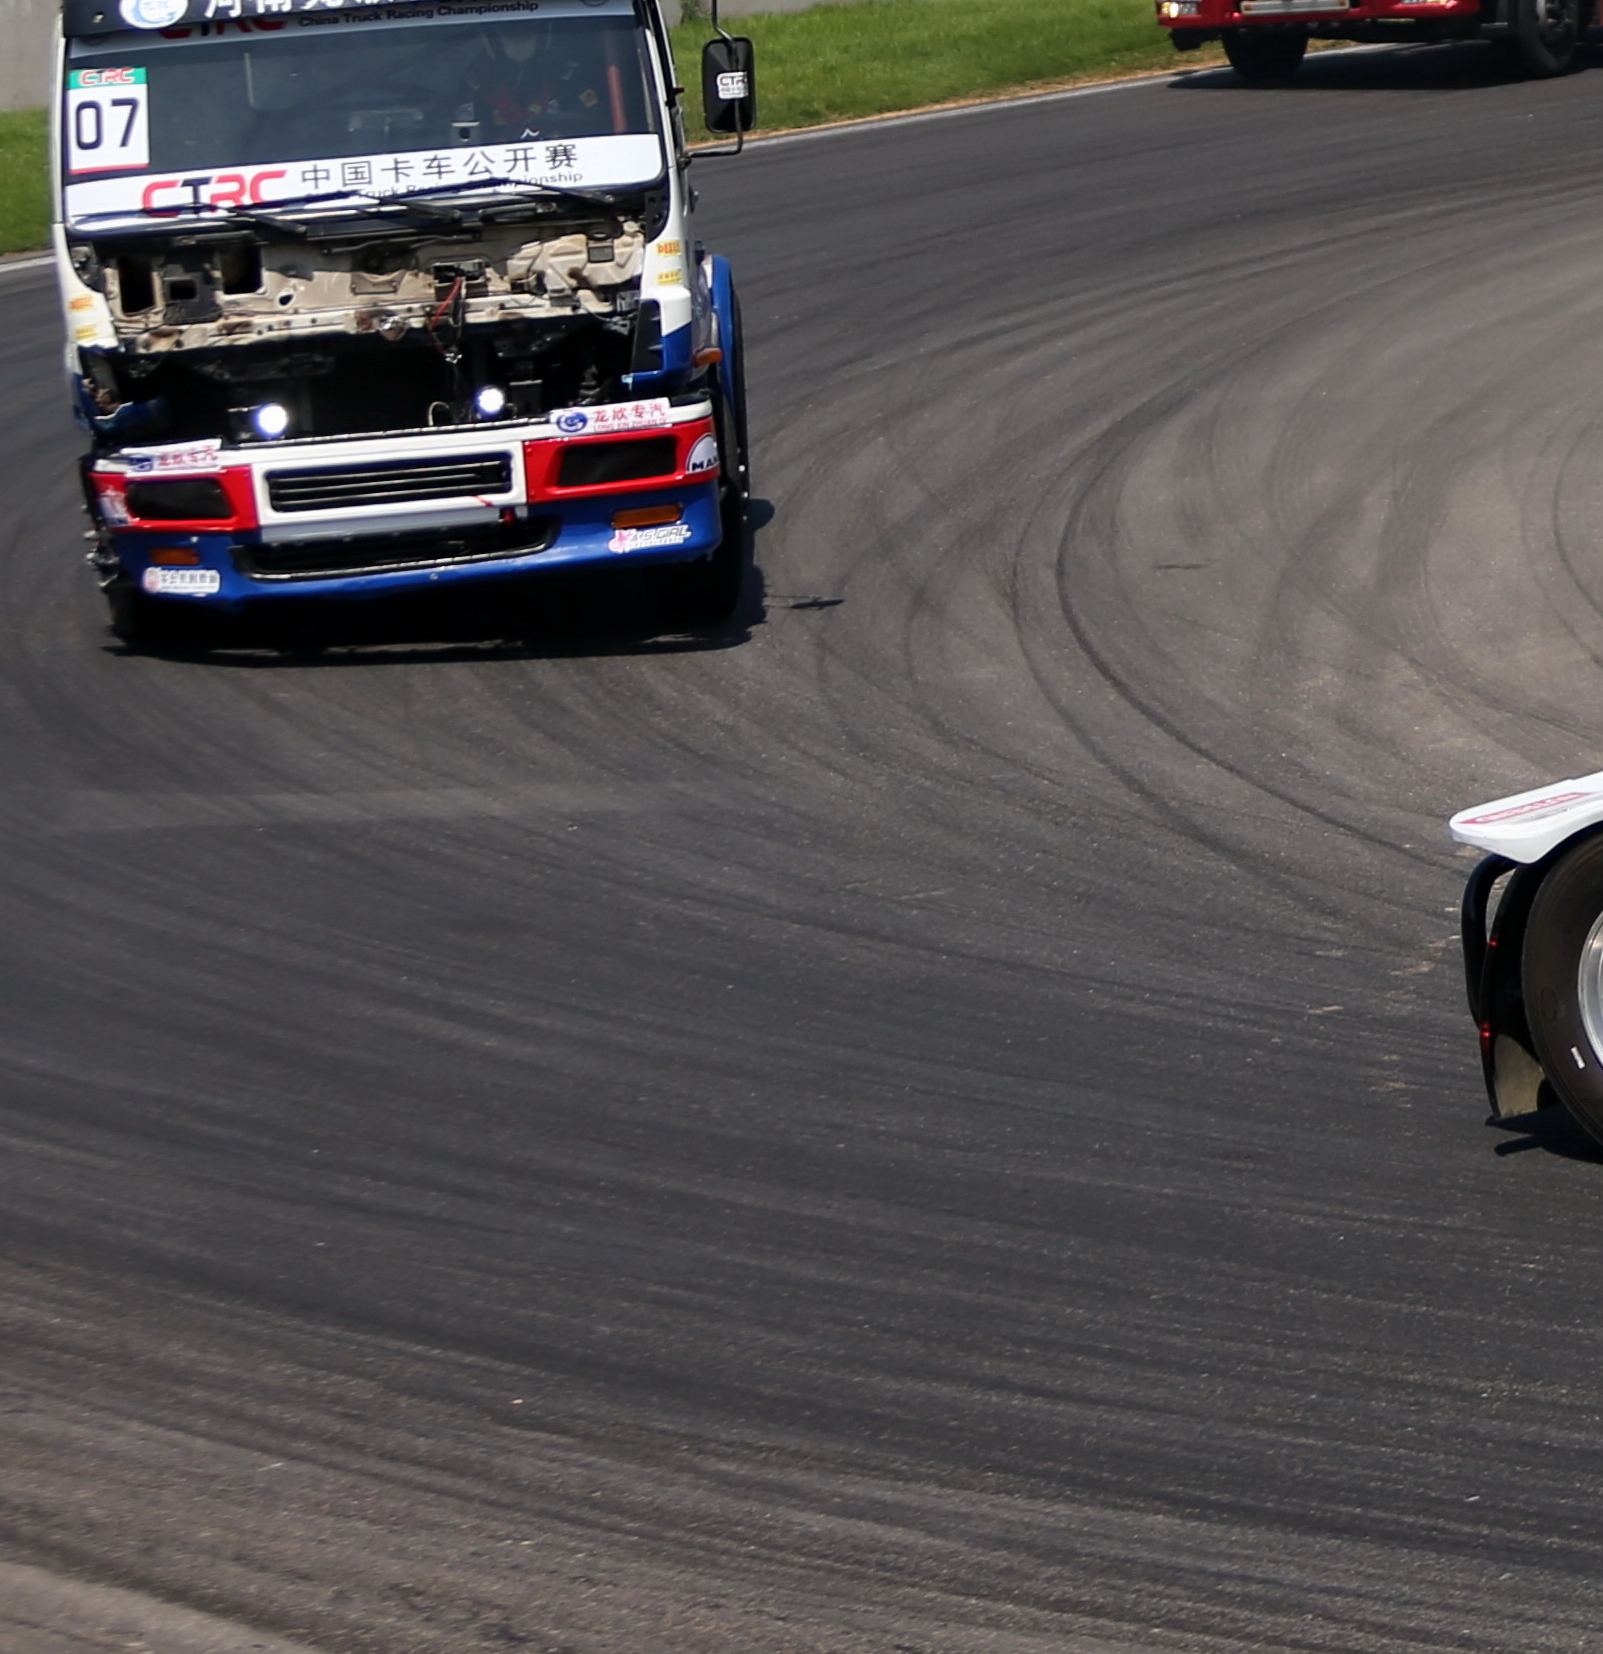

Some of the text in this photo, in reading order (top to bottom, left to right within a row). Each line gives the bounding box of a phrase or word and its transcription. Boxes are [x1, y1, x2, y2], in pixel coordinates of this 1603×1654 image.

[300, 13, 340, 28] China
[343, 9, 382, 24] Truck
[387, 6, 434, 22] Racing
[438, 0, 539, 17] Championship
[80, 68, 135, 86] CTRC
[75, 97, 140, 151] 07
[301, 143, 578, 190] 中国卡车公开赛
[142, 169, 289, 218] CTRC
